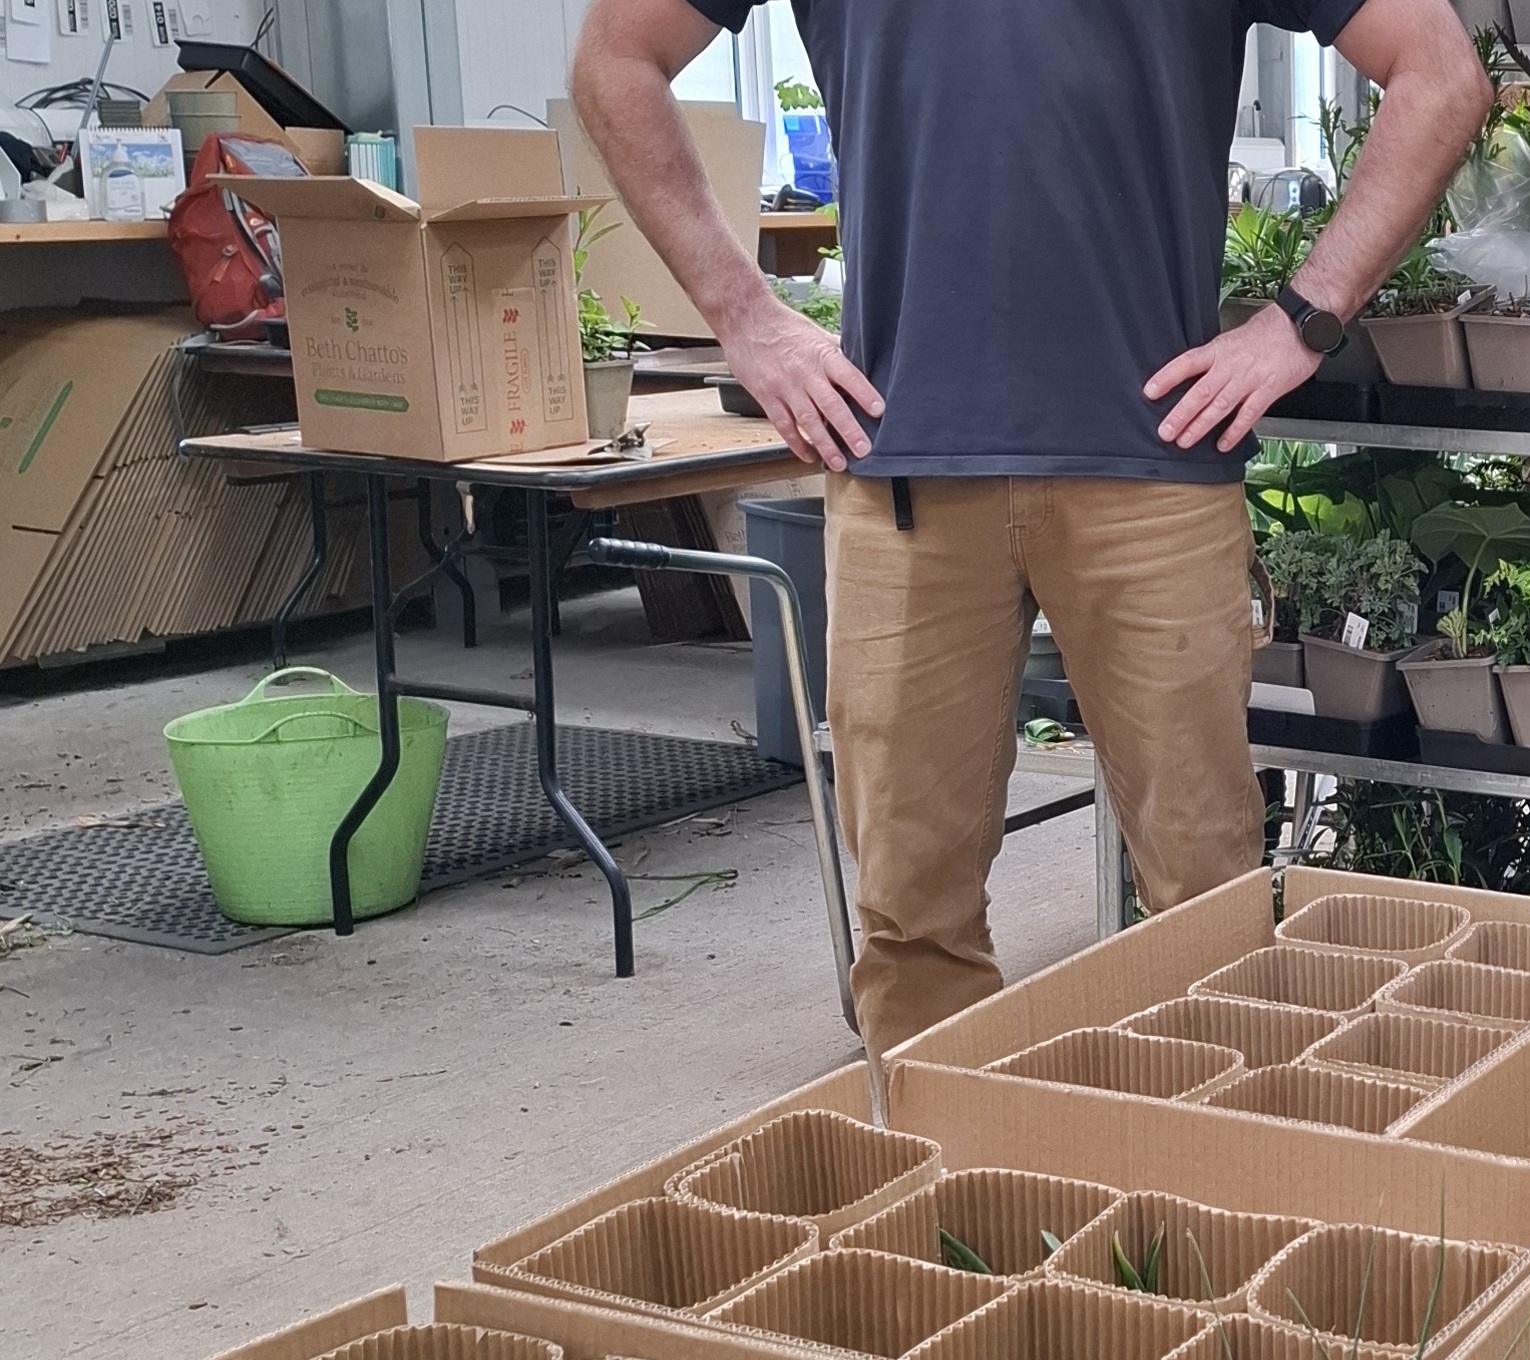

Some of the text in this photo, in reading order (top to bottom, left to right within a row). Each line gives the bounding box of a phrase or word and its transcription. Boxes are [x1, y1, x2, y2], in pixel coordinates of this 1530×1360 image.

[538, 258, 557, 268] THIS
[448, 264, 467, 274] THIS
[538, 268, 557, 278] WAY
[448, 274, 468, 285] WAY
[539, 278, 550, 288] UP
[449, 285, 462, 295] UP
[305, 336, 408, 365] Beth Chatto's
[357, 366, 407, 384] Gardens
[503, 331, 522, 412] FRAGILE
[548, 385, 567, 395] THIS
[459, 395, 480, 405] THIS
[549, 395, 567, 405] WAY
[461, 405, 480, 416] WAY
[550, 405, 561, 415] UP
[462, 416, 474, 426] UP
